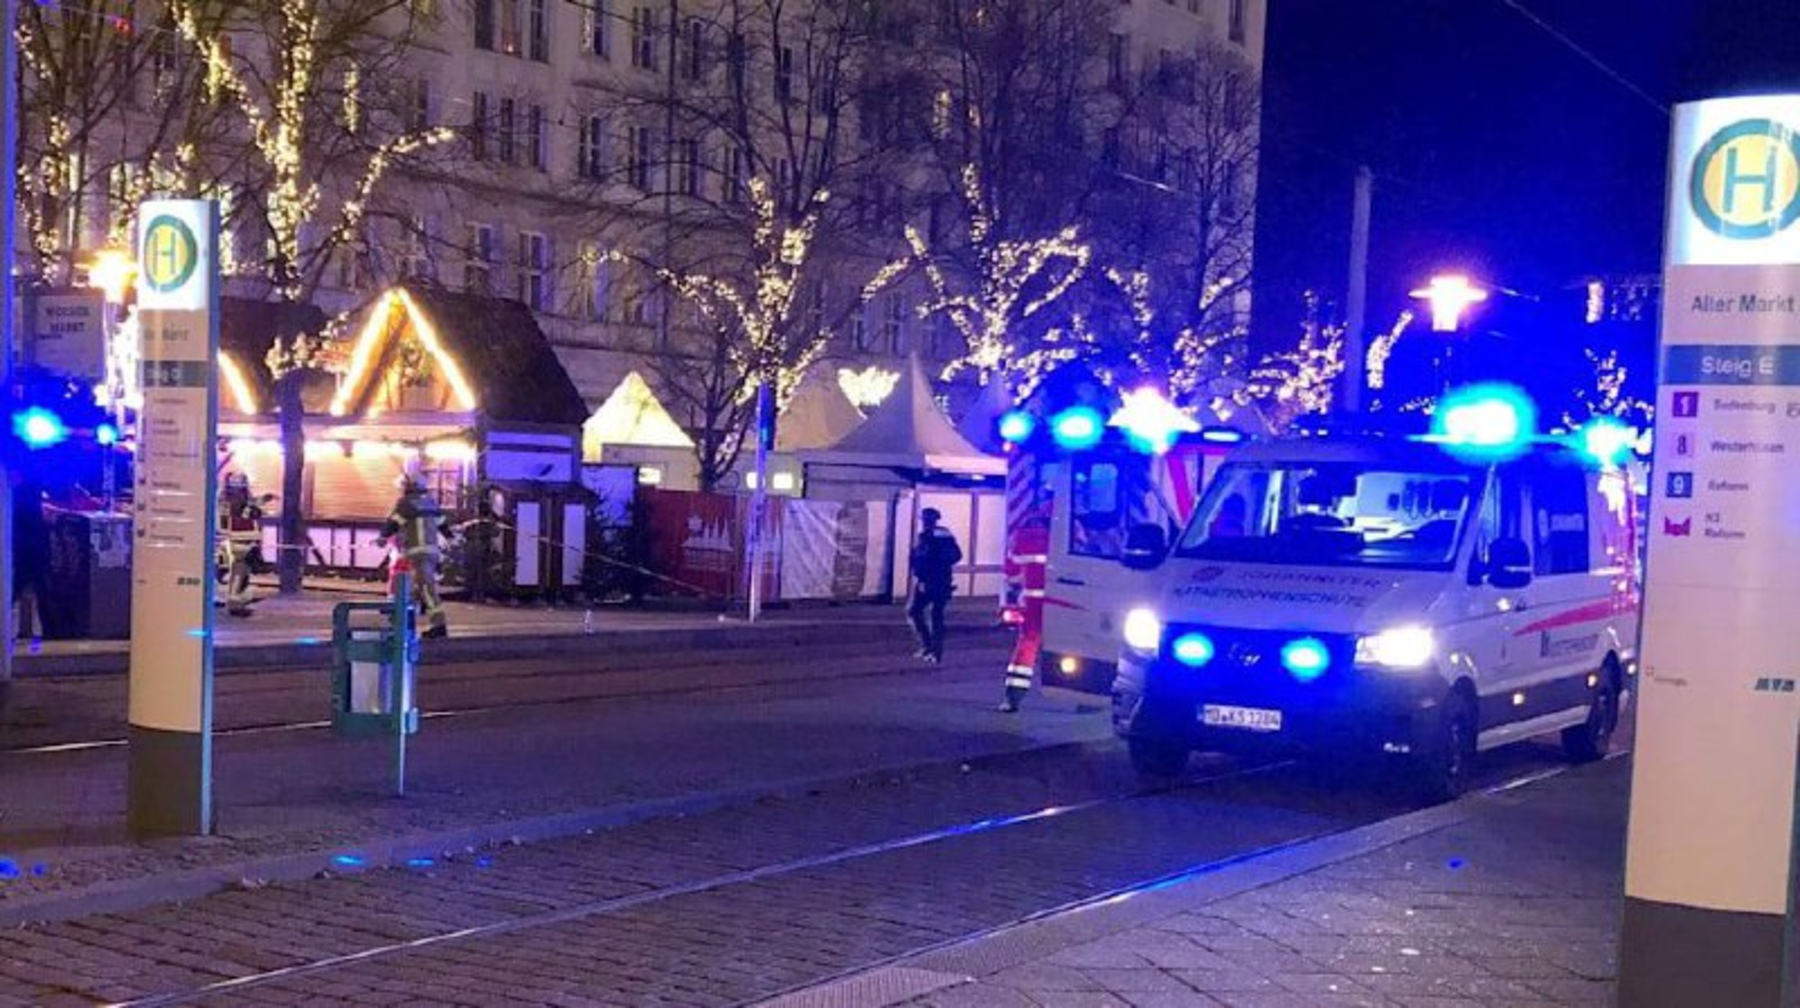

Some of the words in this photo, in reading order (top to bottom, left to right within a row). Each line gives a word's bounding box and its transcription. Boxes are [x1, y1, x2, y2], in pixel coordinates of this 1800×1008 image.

[1722, 145, 1778, 213] H
[151, 231, 177, 277] H
[1738, 294, 1794, 313] Markt
[1701, 355, 1752, 378] Steig
[1758, 355, 1774, 375] E
[1680, 395, 1690, 416] 1
[1677, 434, 1687, 455] 8
[1672, 474, 1684, 495] 9
